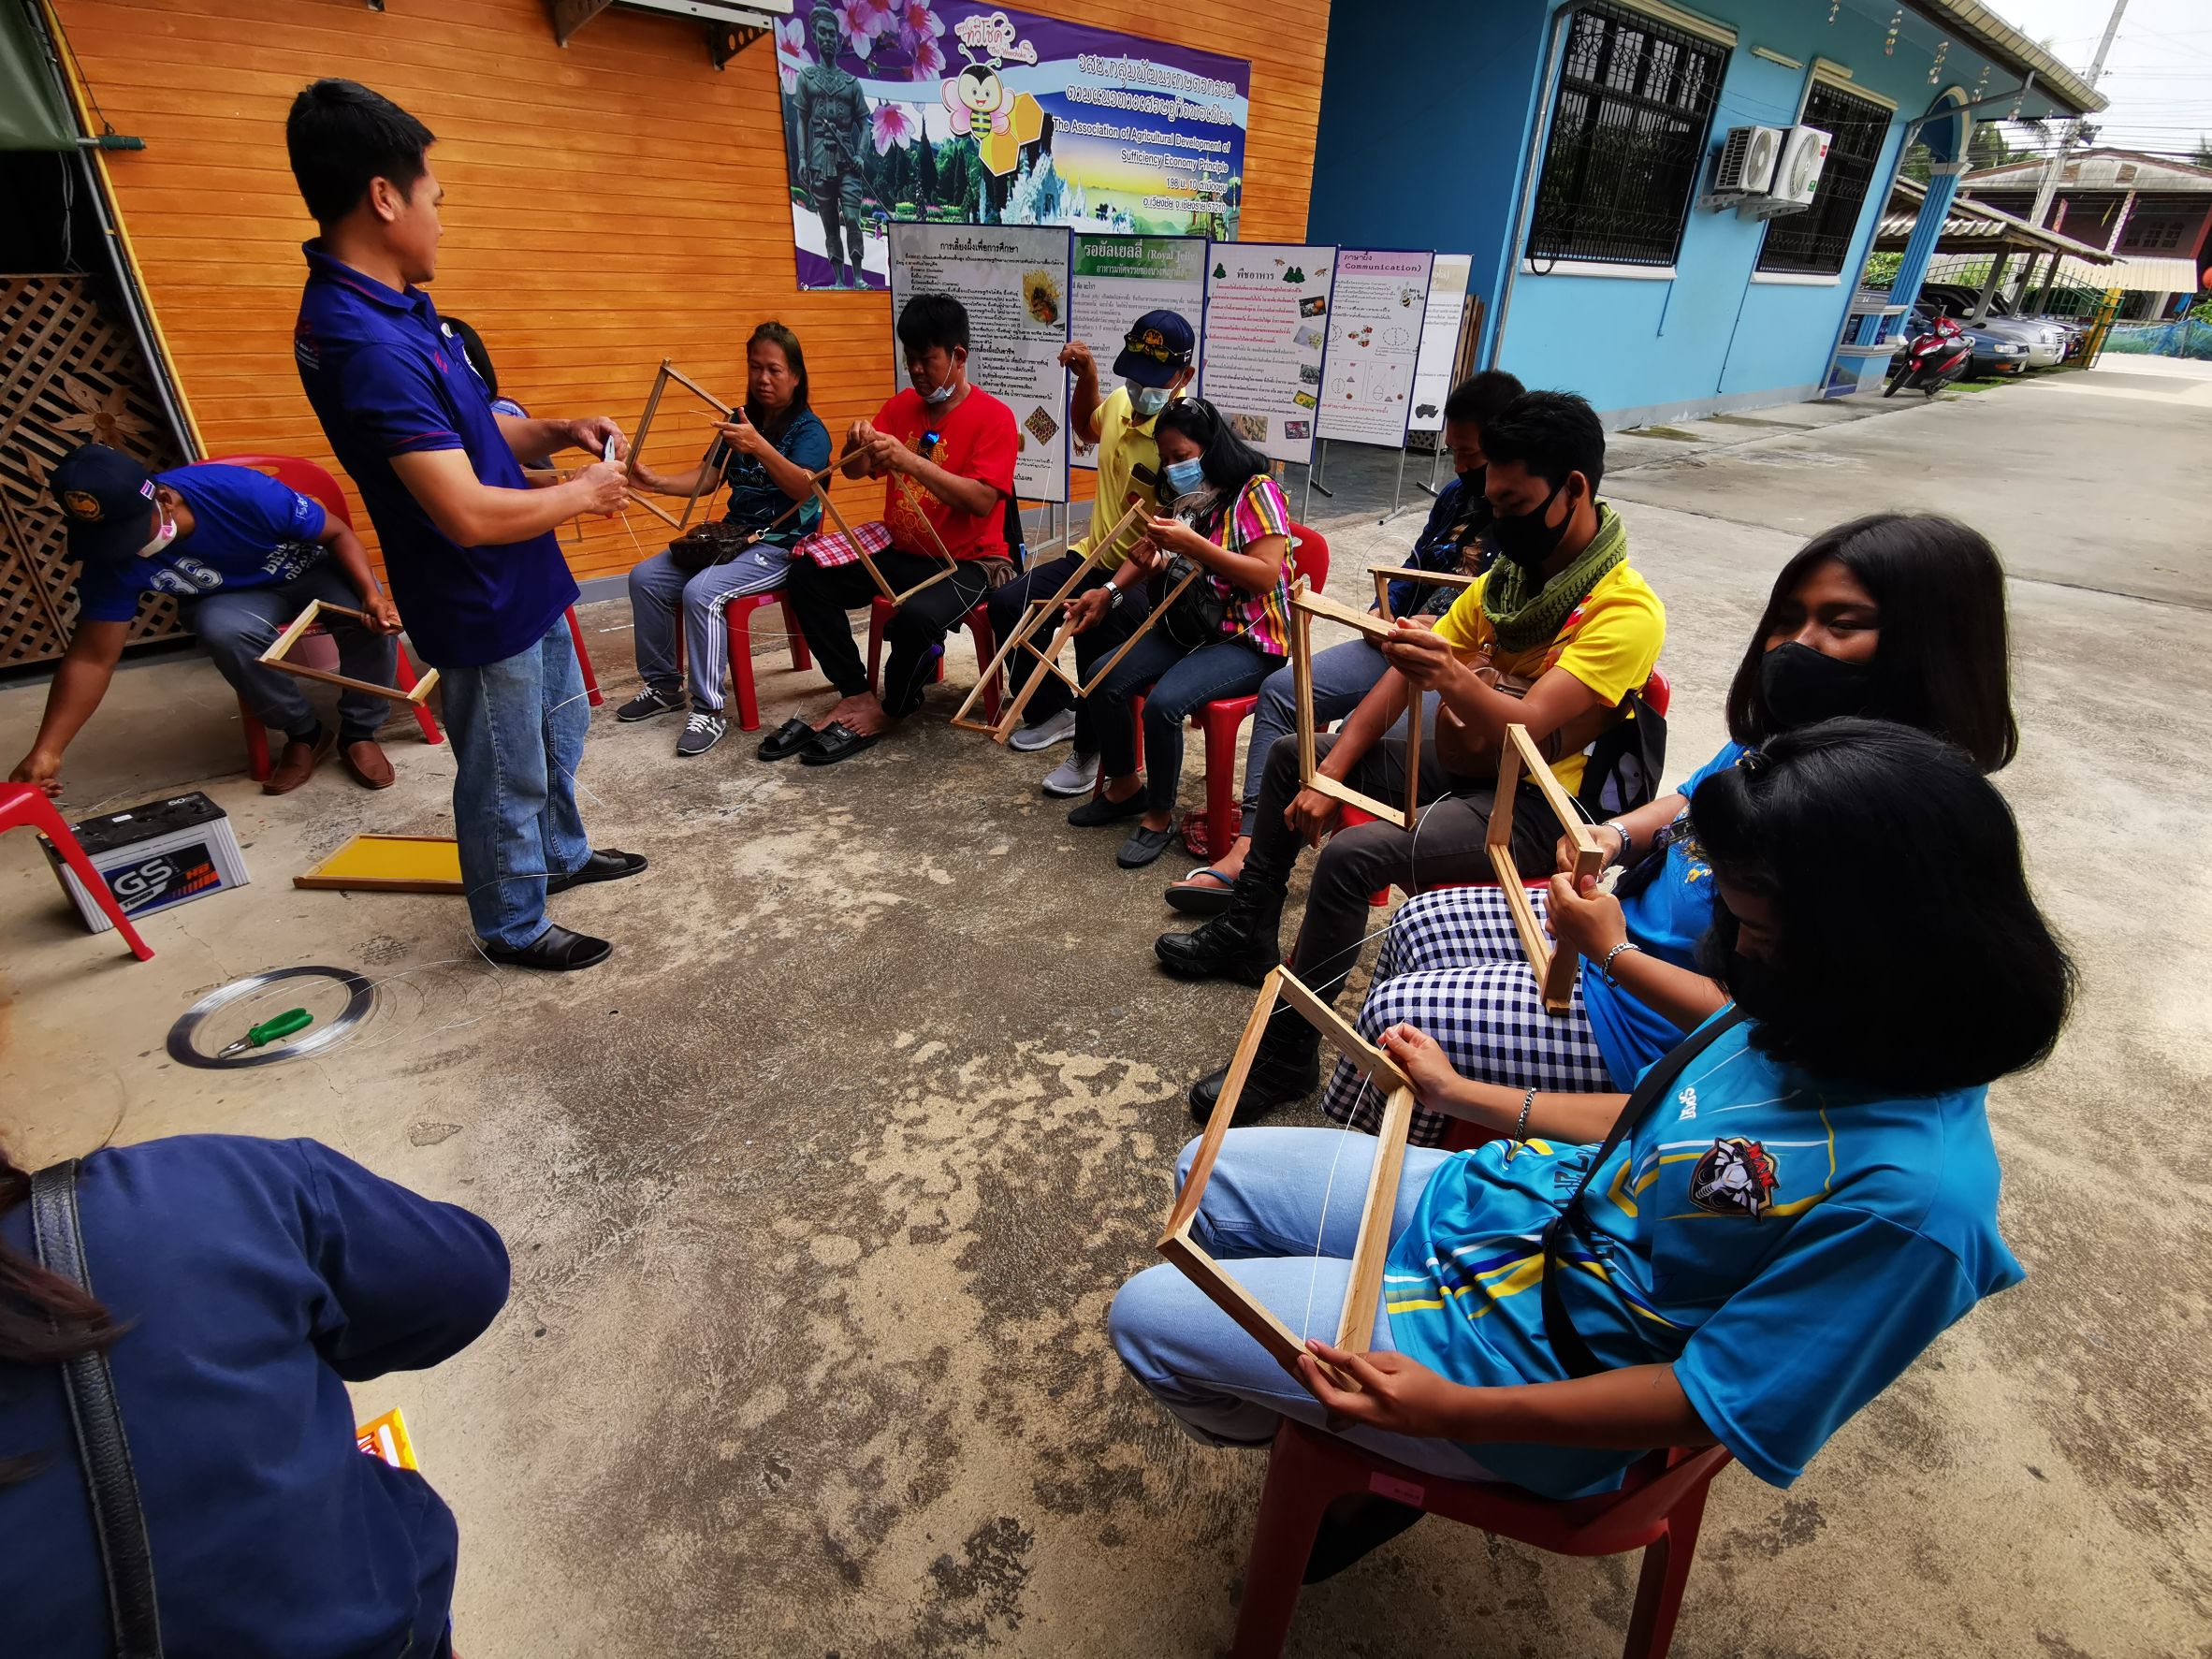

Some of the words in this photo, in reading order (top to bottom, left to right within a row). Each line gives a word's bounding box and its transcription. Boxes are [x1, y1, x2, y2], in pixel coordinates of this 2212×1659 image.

[1053, 118, 1069, 133] The
[1071, 120, 1118, 139] Association
[1120, 128, 1129, 139] of
[1131, 128, 1173, 145] Agricultural
[1175, 137, 1221, 153] Development
[1222, 141, 1230, 153] of
[1121, 151, 1163, 167] Sufficiency
[1164, 155, 1197, 172] Economy
[1199, 158, 1229, 174] Principle
[1167, 178, 1180, 189] 198
[1189, 180, 1197, 191] 10
[1207, 202, 1226, 214] 57210
[939, 238, 1019, 254] การเลี้ยงผึ้งเพื่อการศึกษา
[1084, 240, 1142, 259] รอยัลเยลลี่
[1147, 251, 1173, 263] (Royal
[1237, 268, 1274, 280] พืชอาหาร
[1345, 263, 1422, 272] Communication)
[113, 858, 173, 895] GS
